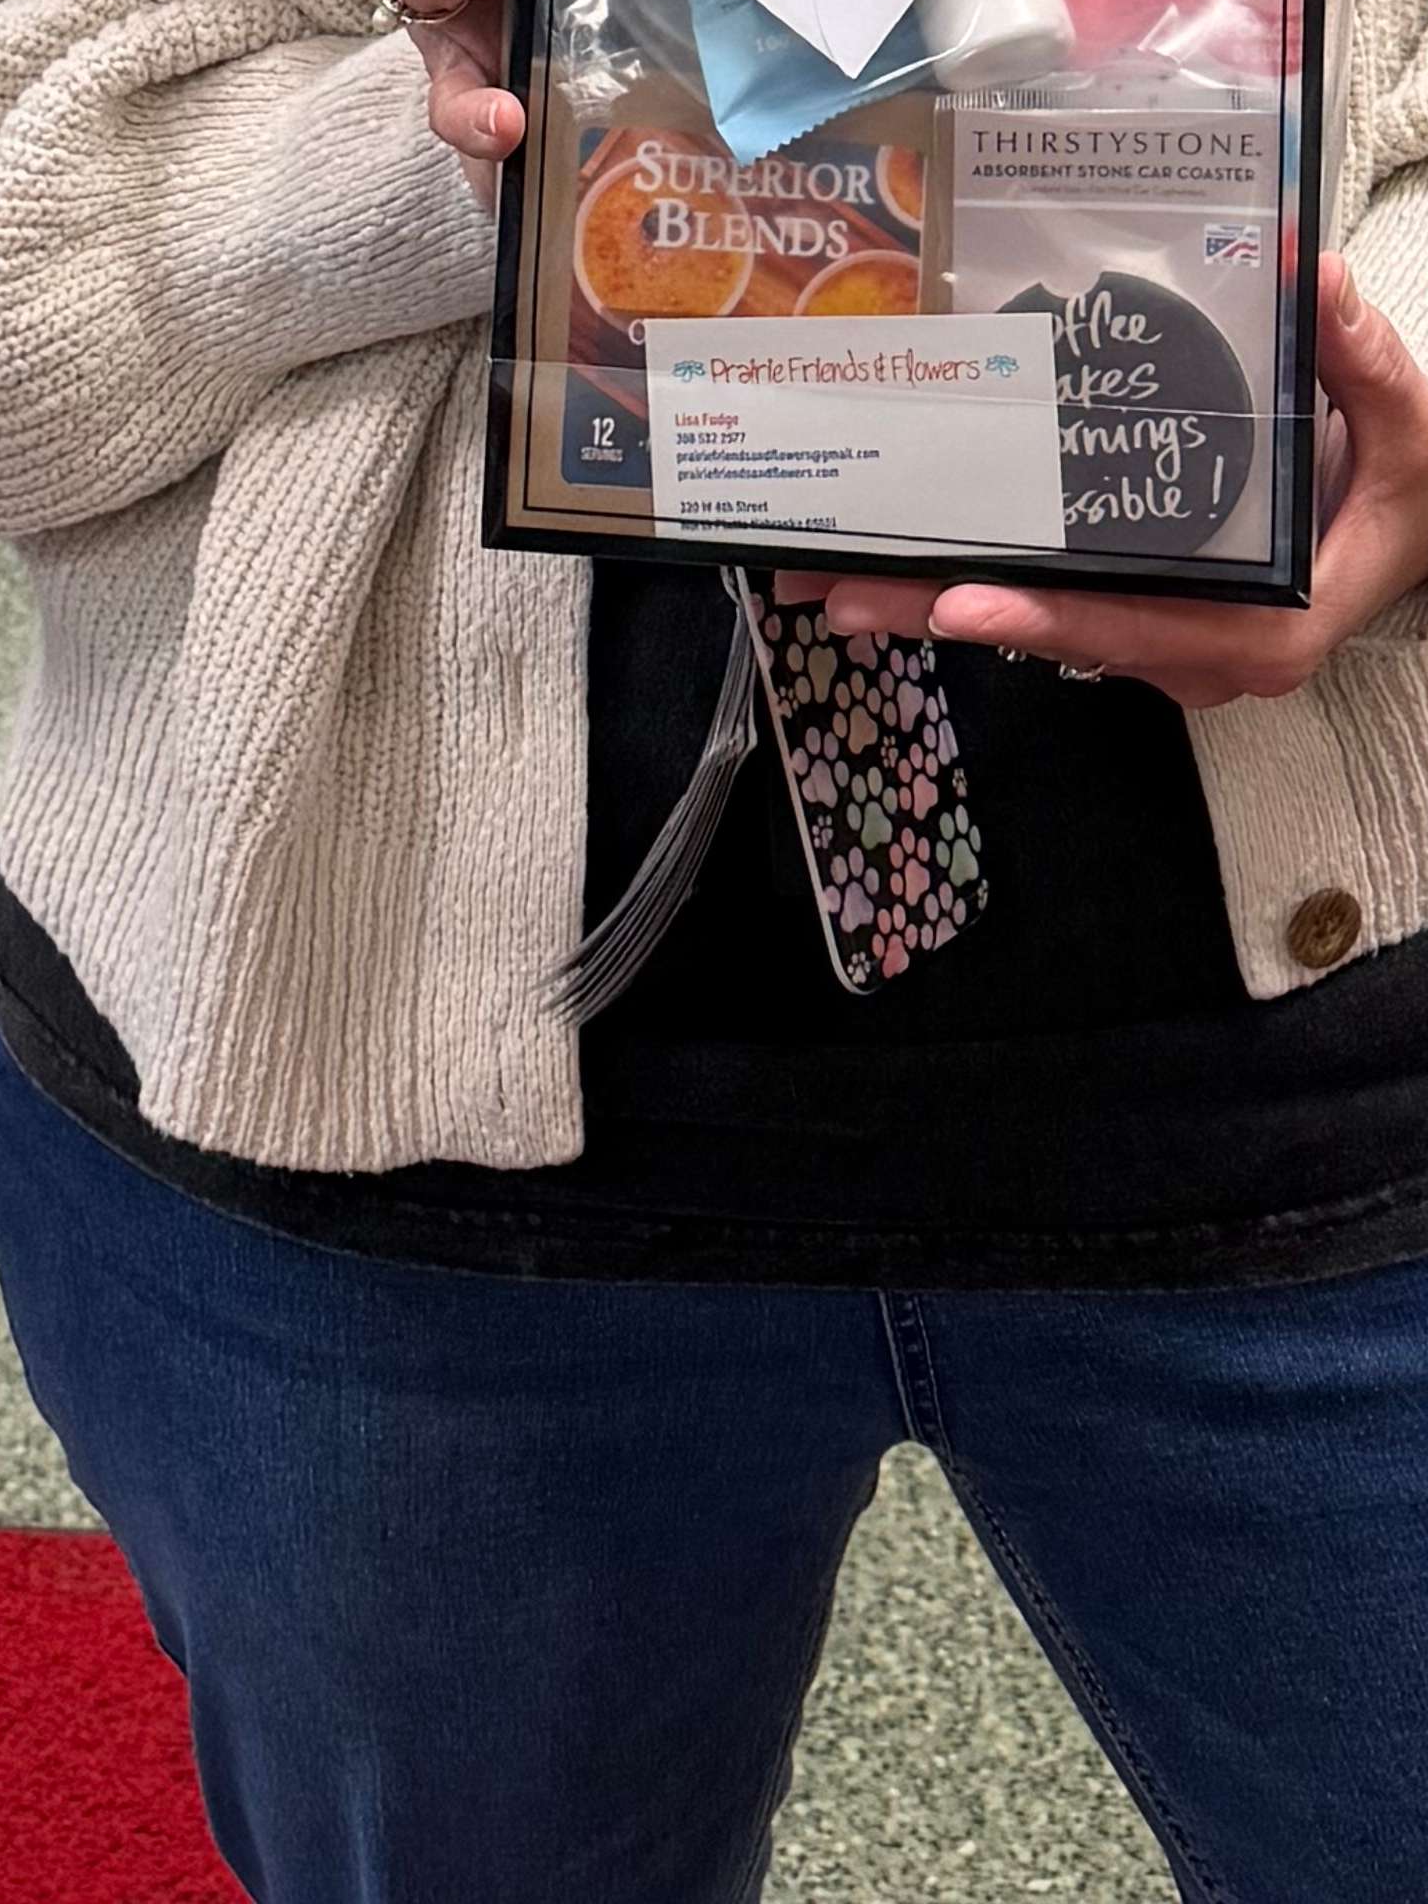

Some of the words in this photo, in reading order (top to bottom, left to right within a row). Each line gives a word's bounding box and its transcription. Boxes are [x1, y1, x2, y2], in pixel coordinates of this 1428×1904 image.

[634, 141, 875, 204] SUPERIOR
[971, 164, 1072, 179] ABSORBENT
[1078, 165, 1132, 179] STONE
[1138, 165, 1172, 179] CAR
[1177, 166, 1256, 182] COASTER
[653, 198, 849, 259] BLENDS
[1053, 291, 1162, 357] offee
[711, 358, 784, 385] Prairie
[788, 349, 869, 384] Friends
[874, 352, 886, 383] &
[892, 348, 980, 387] Flowers
[1056, 363, 1159, 408] akes
[592, 417, 616, 447] 12
[675, 413, 699, 427] Lisa
[702, 412, 739, 430] Fudge
[736, 500, 768, 513] Street
